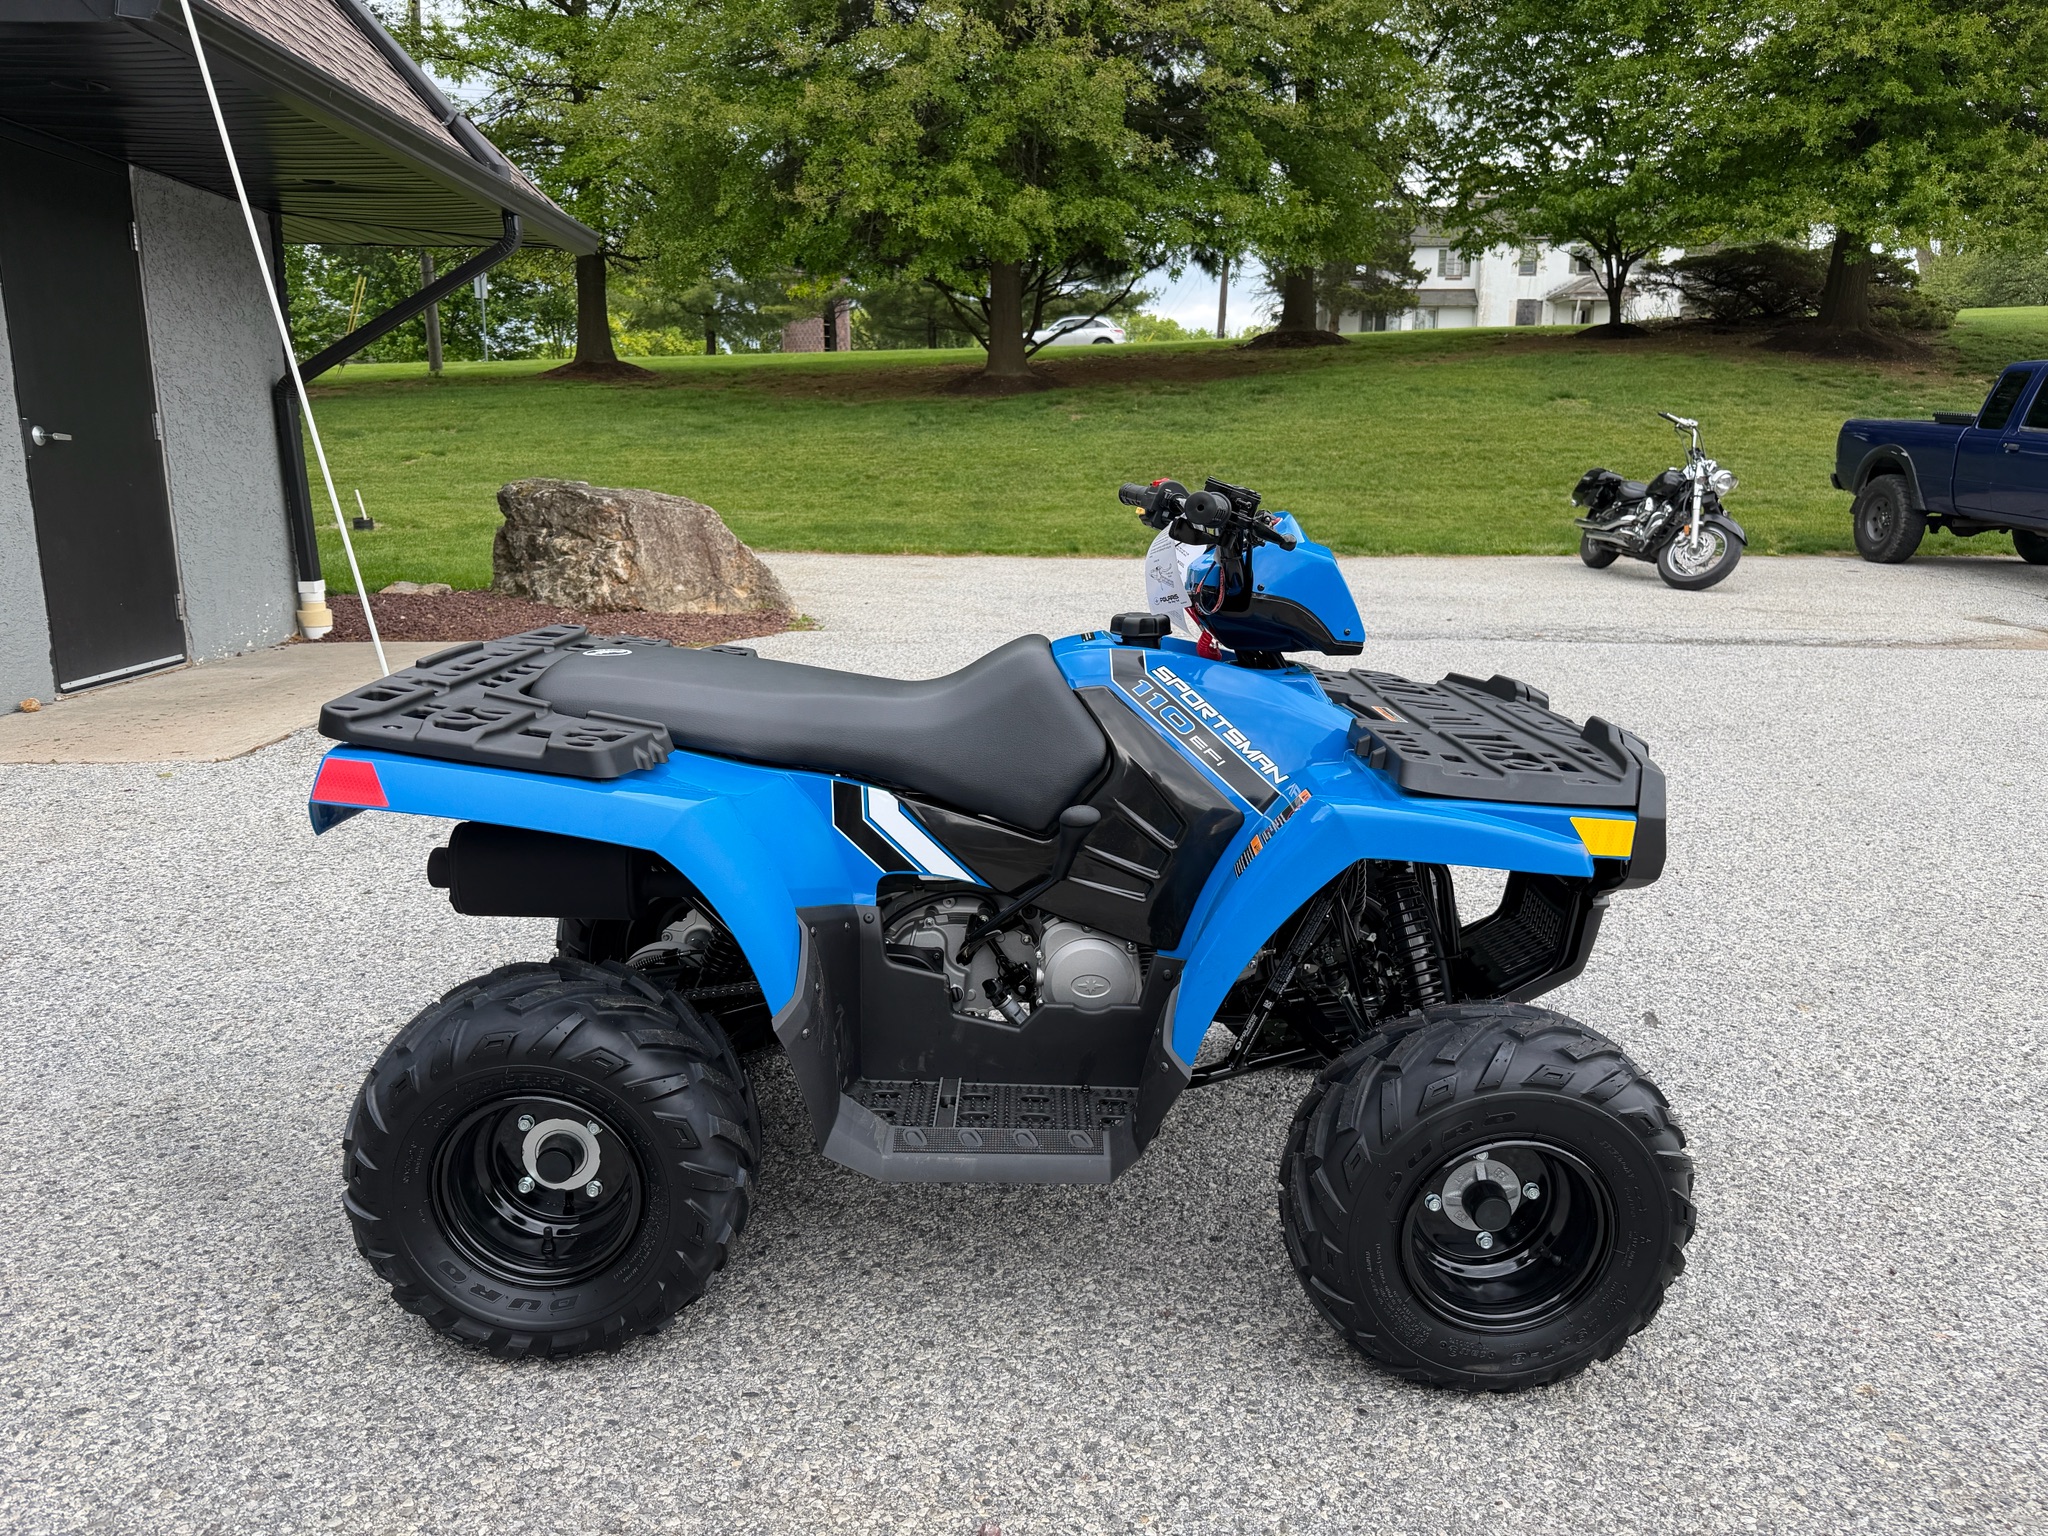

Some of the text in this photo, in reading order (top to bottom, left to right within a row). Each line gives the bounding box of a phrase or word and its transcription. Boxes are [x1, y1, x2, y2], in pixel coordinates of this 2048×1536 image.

[1131, 679, 1226, 767] 110 EFI
[1152, 665, 1290, 785] SPORTSMAN
[437, 1260, 581, 1313] DURO
